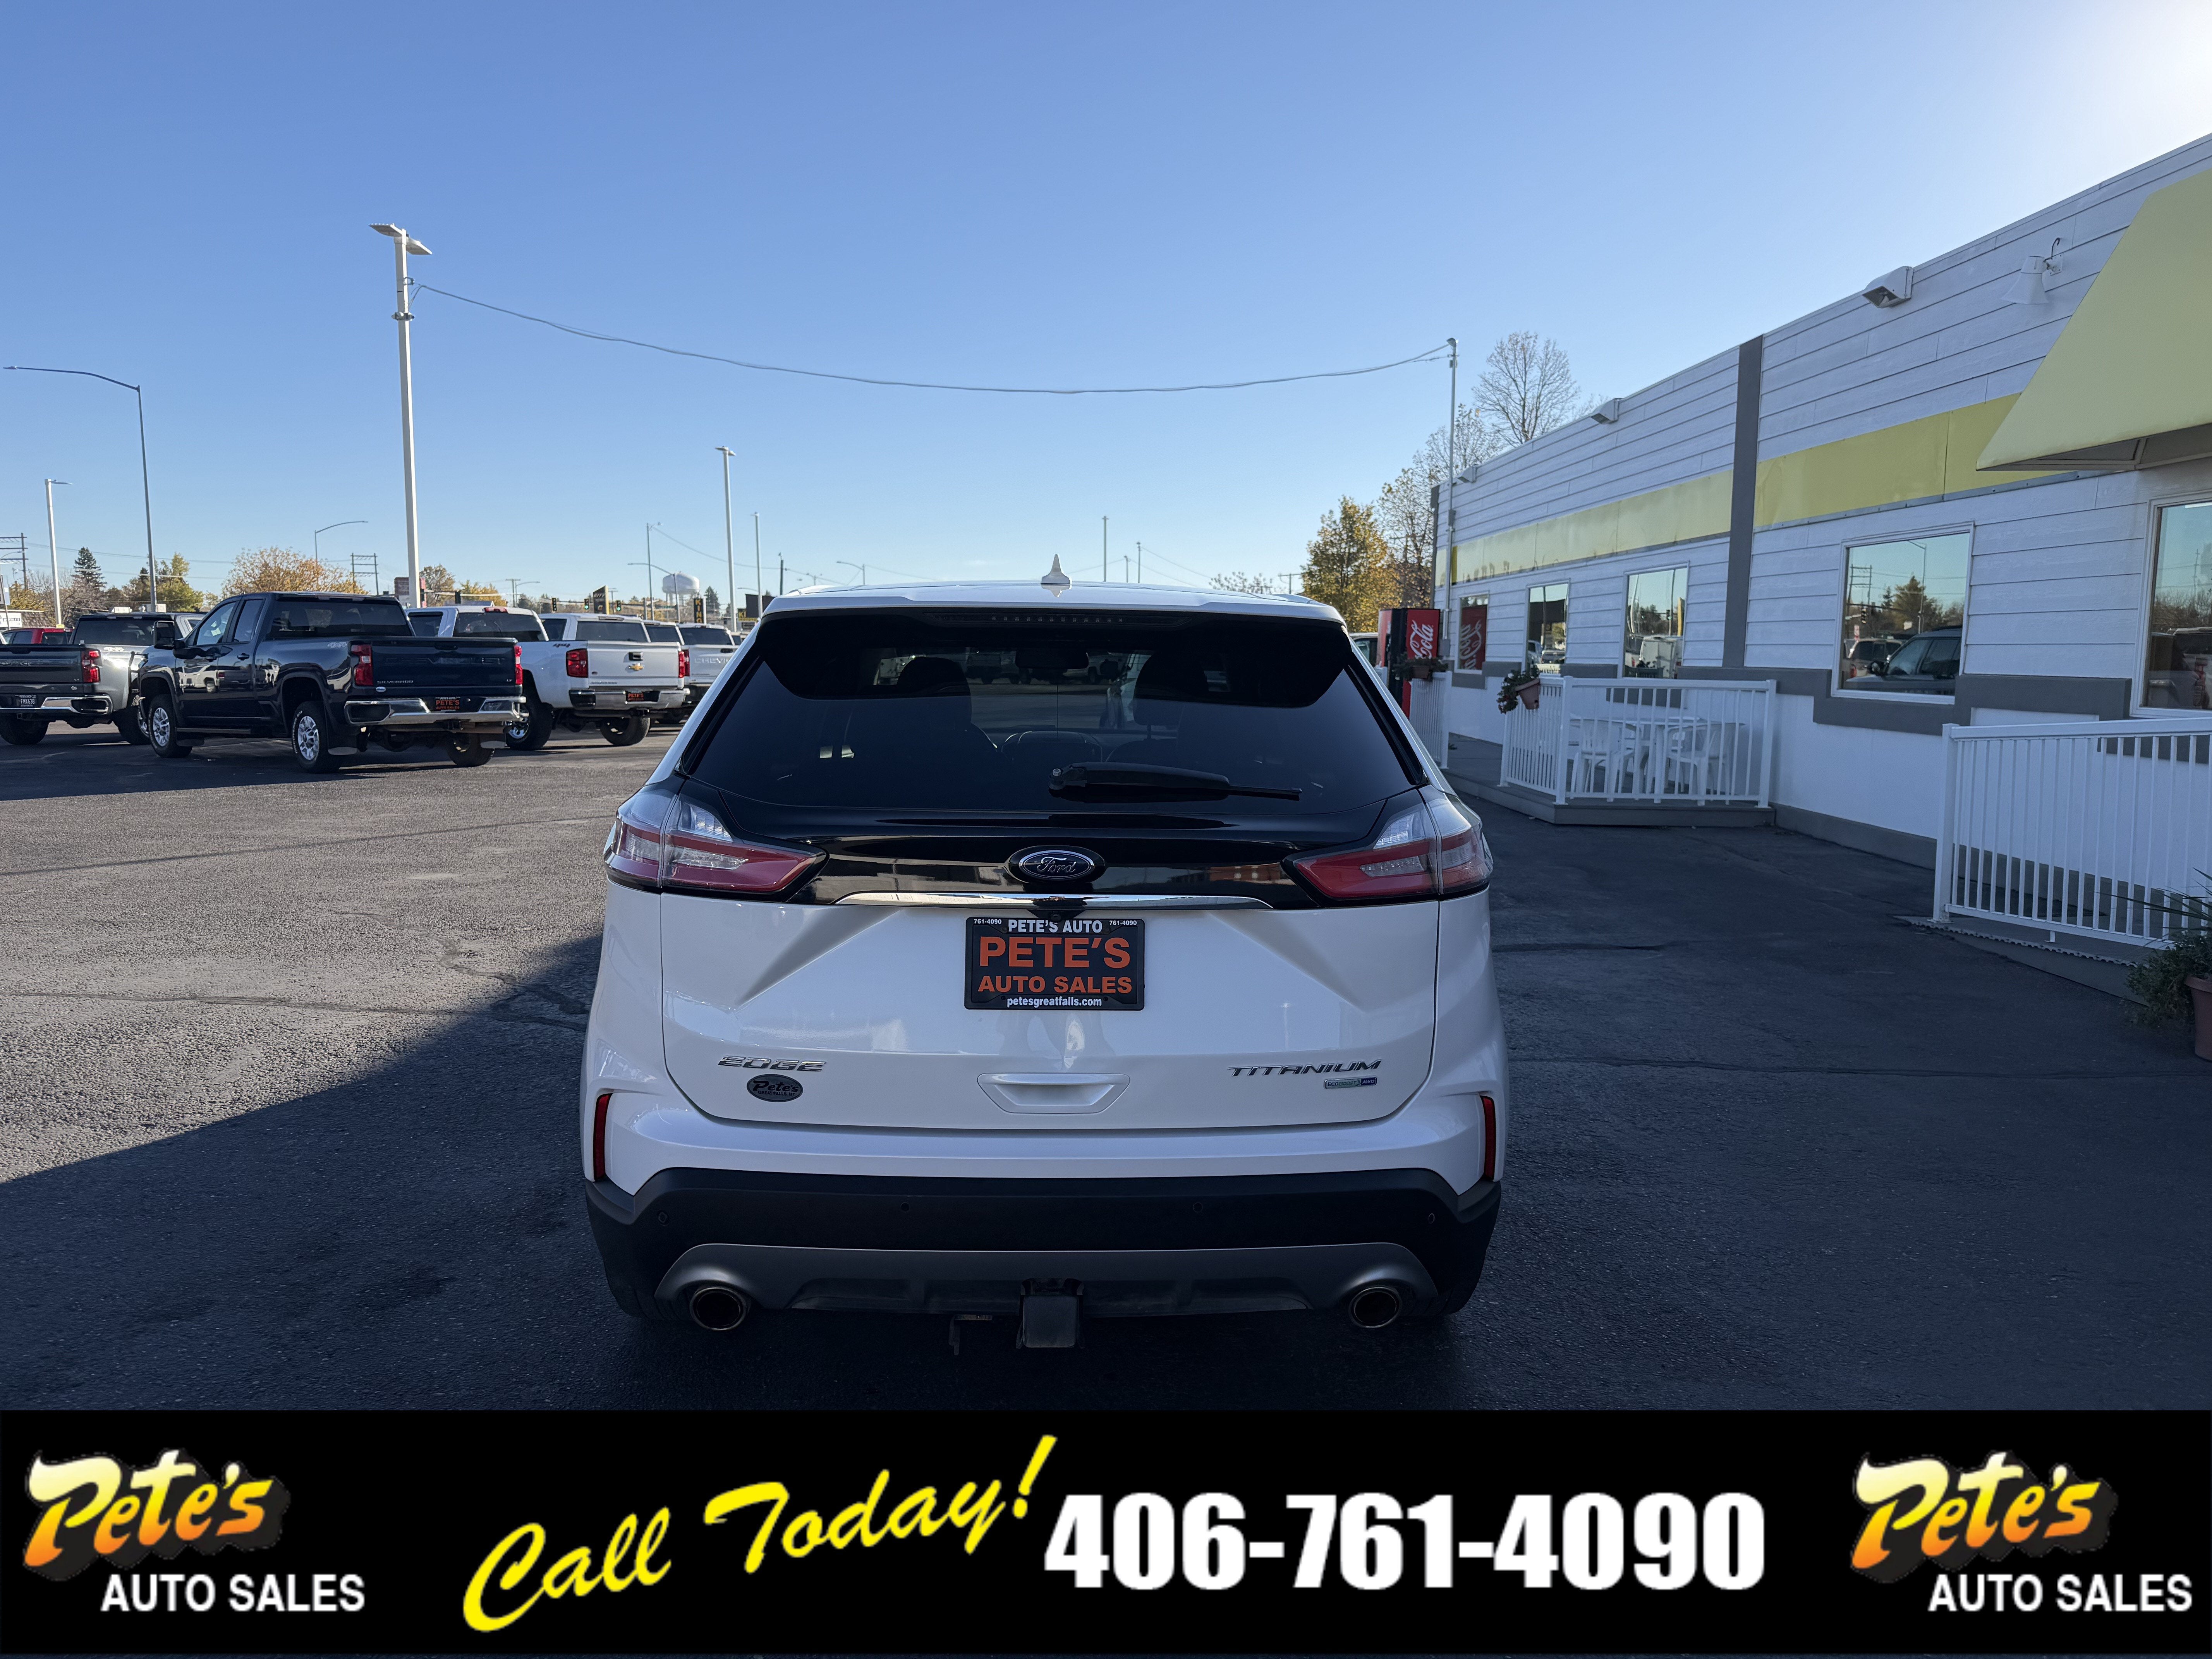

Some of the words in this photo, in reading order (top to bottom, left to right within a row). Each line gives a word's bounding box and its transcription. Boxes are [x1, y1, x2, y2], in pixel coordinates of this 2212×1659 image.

[1037, 856, 1076, 873] Ford
[1008, 919, 1058, 933] PETE'S
[1063, 920, 1103, 933] AUTO
[980, 936, 1130, 969] PETE'S
[978, 975, 1046, 993] AUTO
[1054, 976, 1132, 994] SALES
[1007, 996, 1102, 1008] petesgreatfalls.com
[718, 1055, 826, 1072] EDGE
[1228, 1059, 1382, 1076] TITANIUM
[753, 1080, 799, 1092] Pete's
